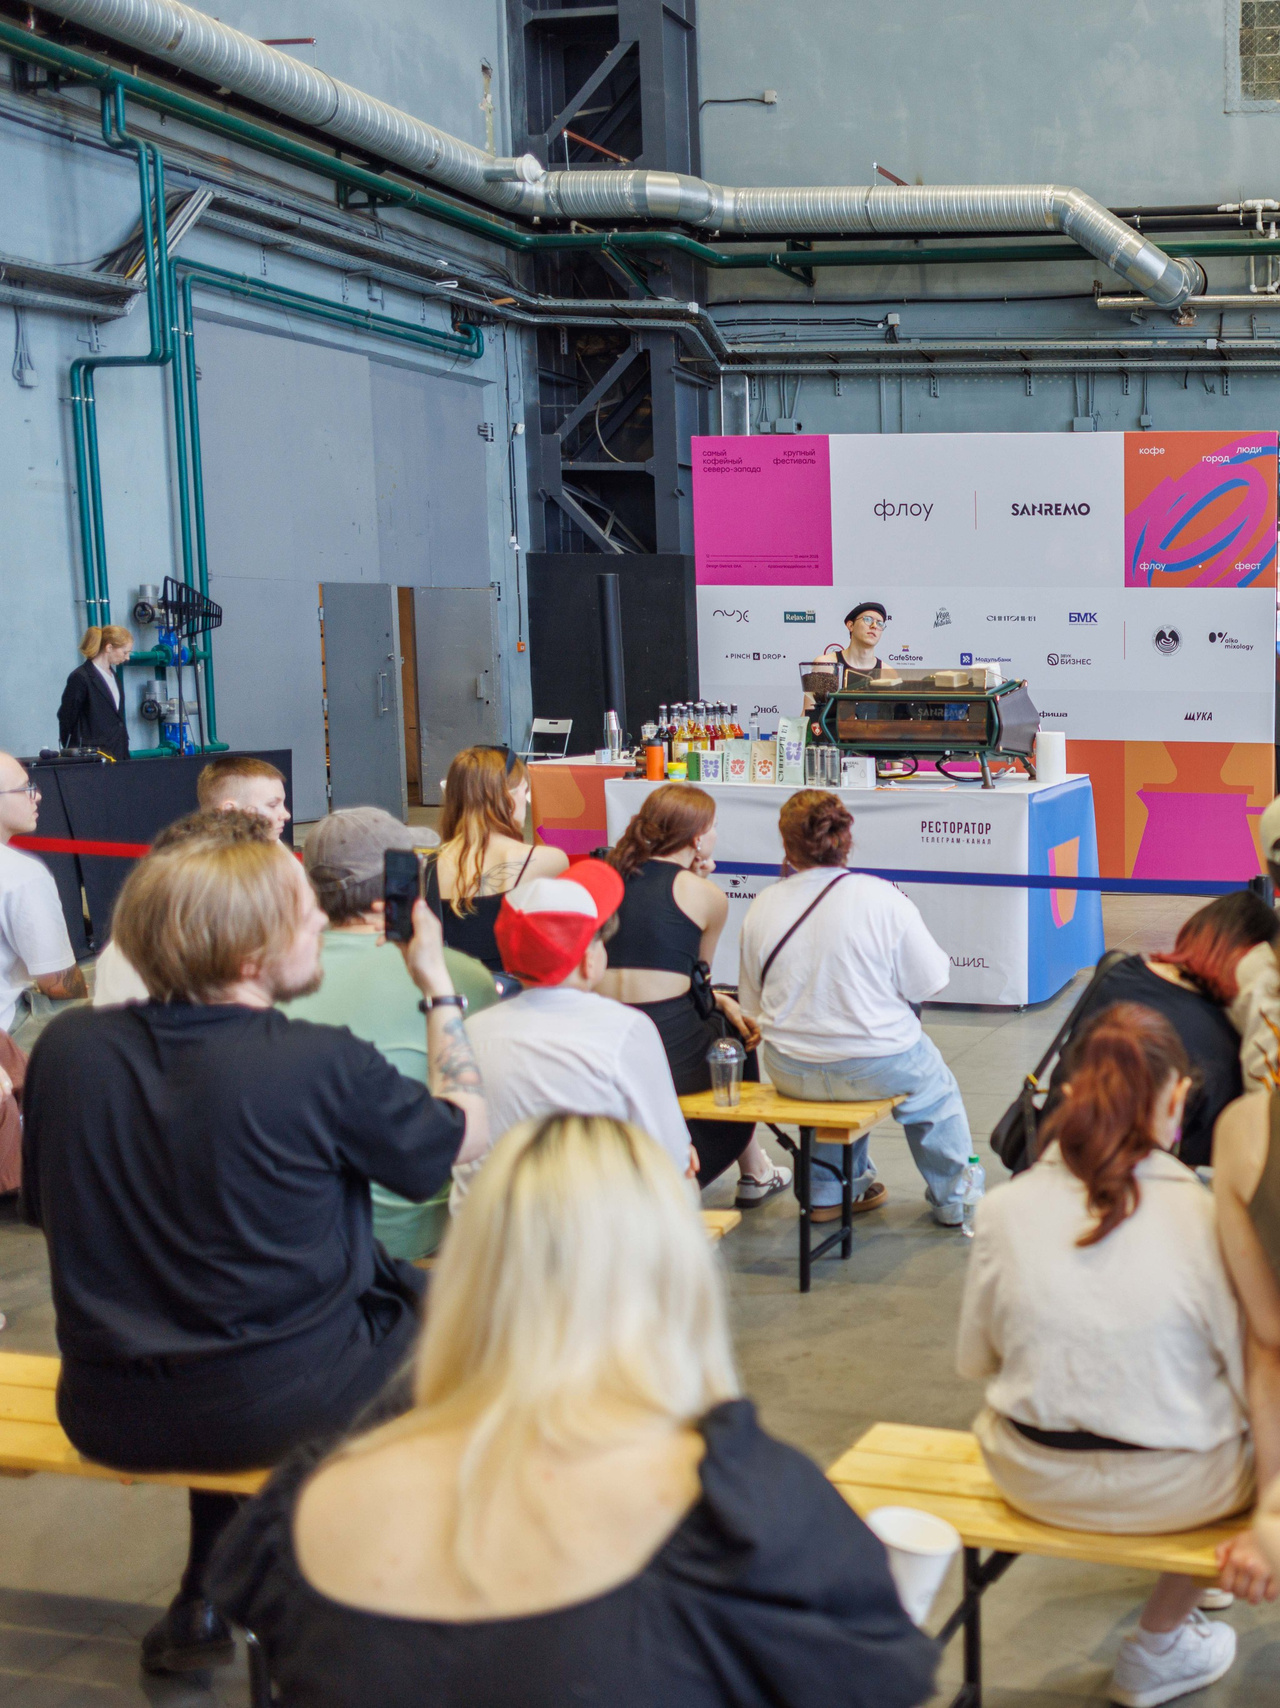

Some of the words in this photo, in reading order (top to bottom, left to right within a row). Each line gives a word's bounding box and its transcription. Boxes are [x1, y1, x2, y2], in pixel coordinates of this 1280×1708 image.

[702, 449, 727, 457] самый
[783, 449, 816, 457] крупный
[1139, 446, 1165, 456] кофе
[1202, 455, 1230, 464] город
[1236, 446, 1262, 454] люди
[702, 457, 743, 466] кофейный
[772, 457, 816, 466] фестиваль
[703, 466, 762, 474] северо-запада
[873, 498, 934, 521] флоу
[1011, 502, 1091, 516] SANREMO
[1139, 562, 1166, 571] флоу
[1235, 561, 1261, 571] фест
[1068, 612, 1098, 623] БМК
[1208, 632, 1228, 643] 0%
[1224, 643, 1254, 651] mixology
[888, 653, 924, 662] CafeStore
[1039, 710, 1068, 718] фиша
[921, 820, 992, 835] РЕСТОРАТОР
[921, 836, 992, 845] ТЕЛЕГРАМ-КАНАЛ
